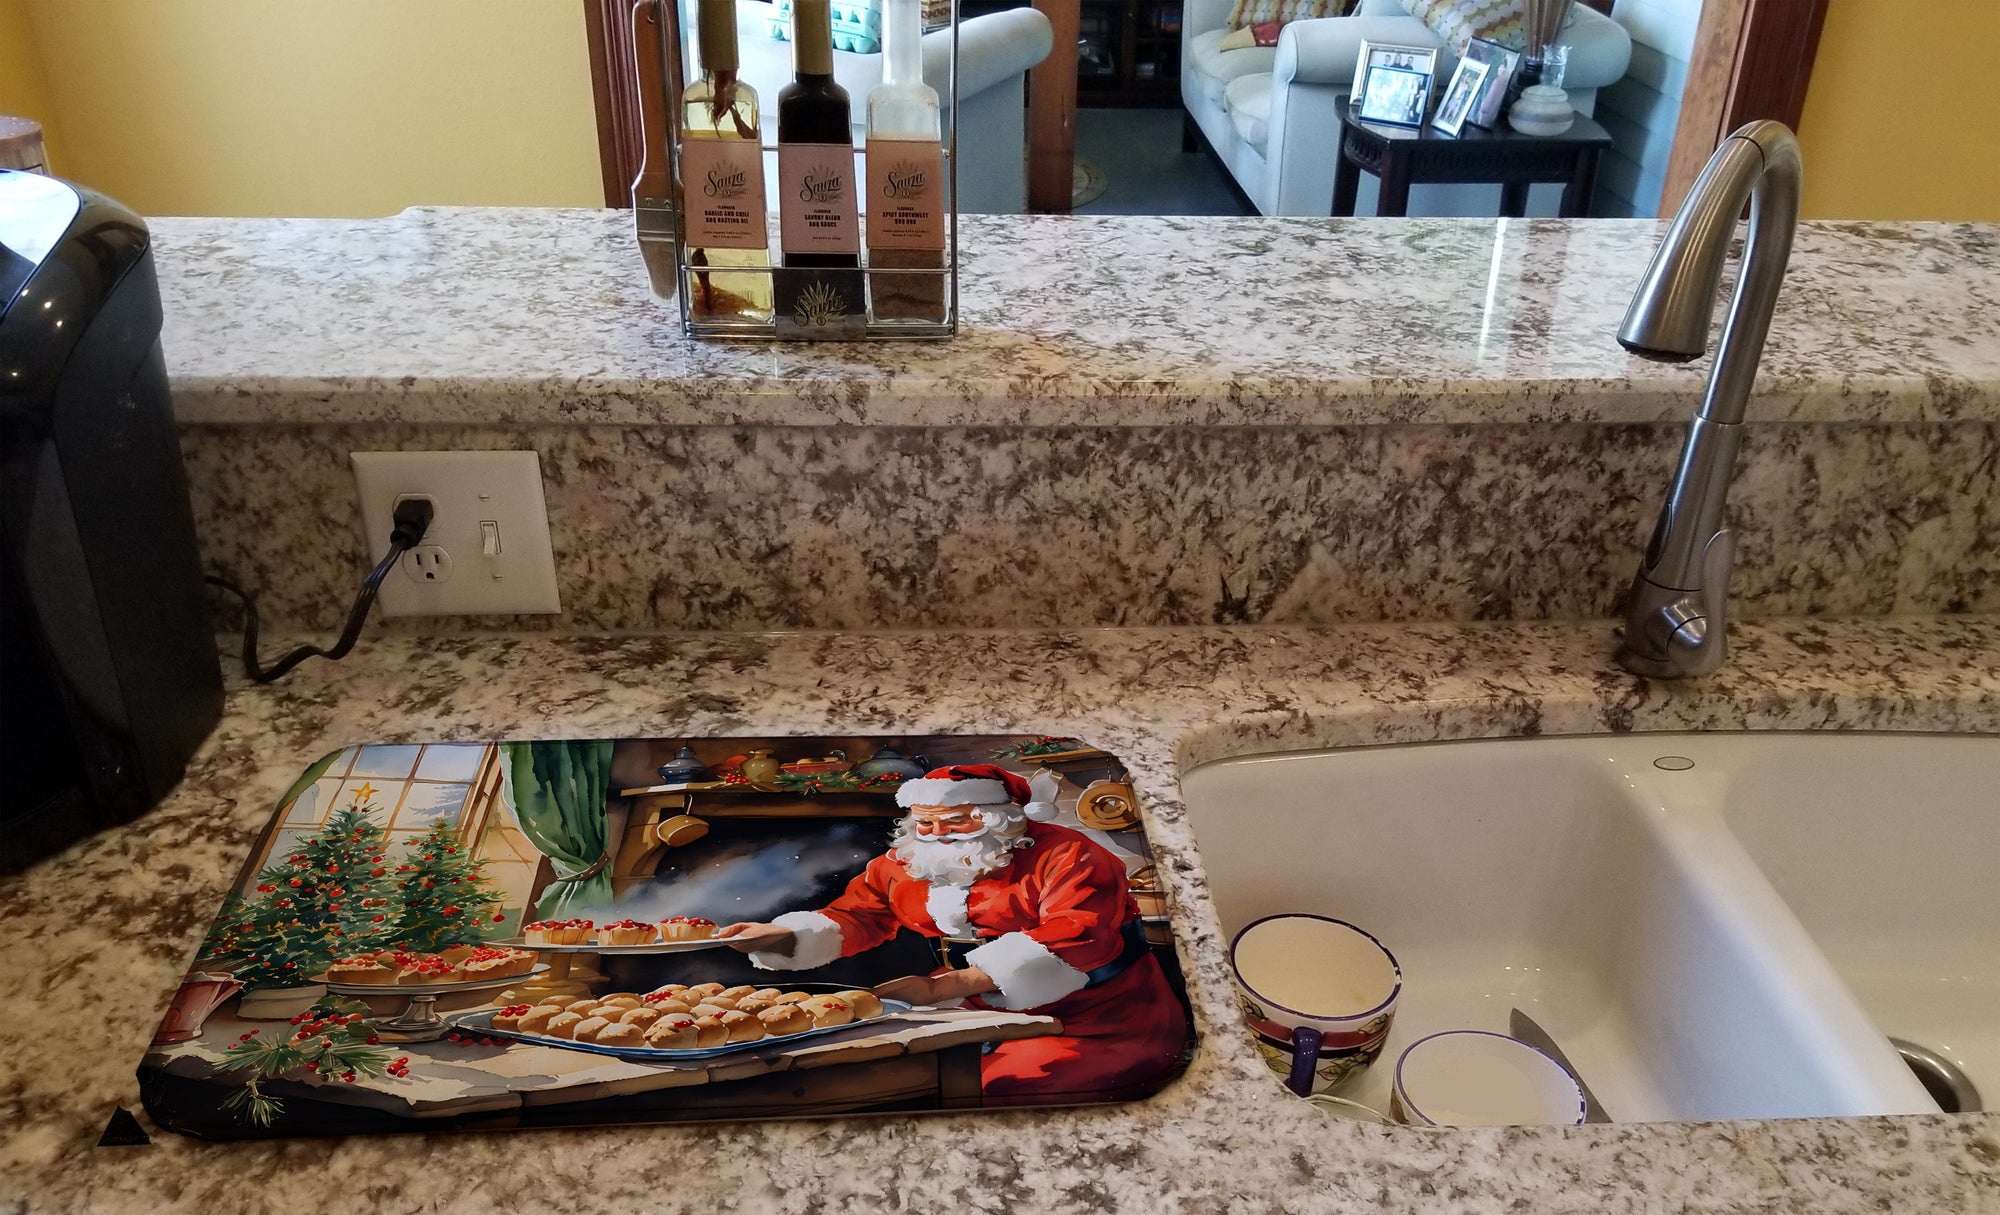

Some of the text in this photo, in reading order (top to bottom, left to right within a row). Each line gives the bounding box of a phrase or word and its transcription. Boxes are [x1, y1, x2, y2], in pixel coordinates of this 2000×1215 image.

[703, 170, 745, 197] Sauza
[800, 175, 841, 202] Sauza
[883, 170, 925, 198] Sauza
